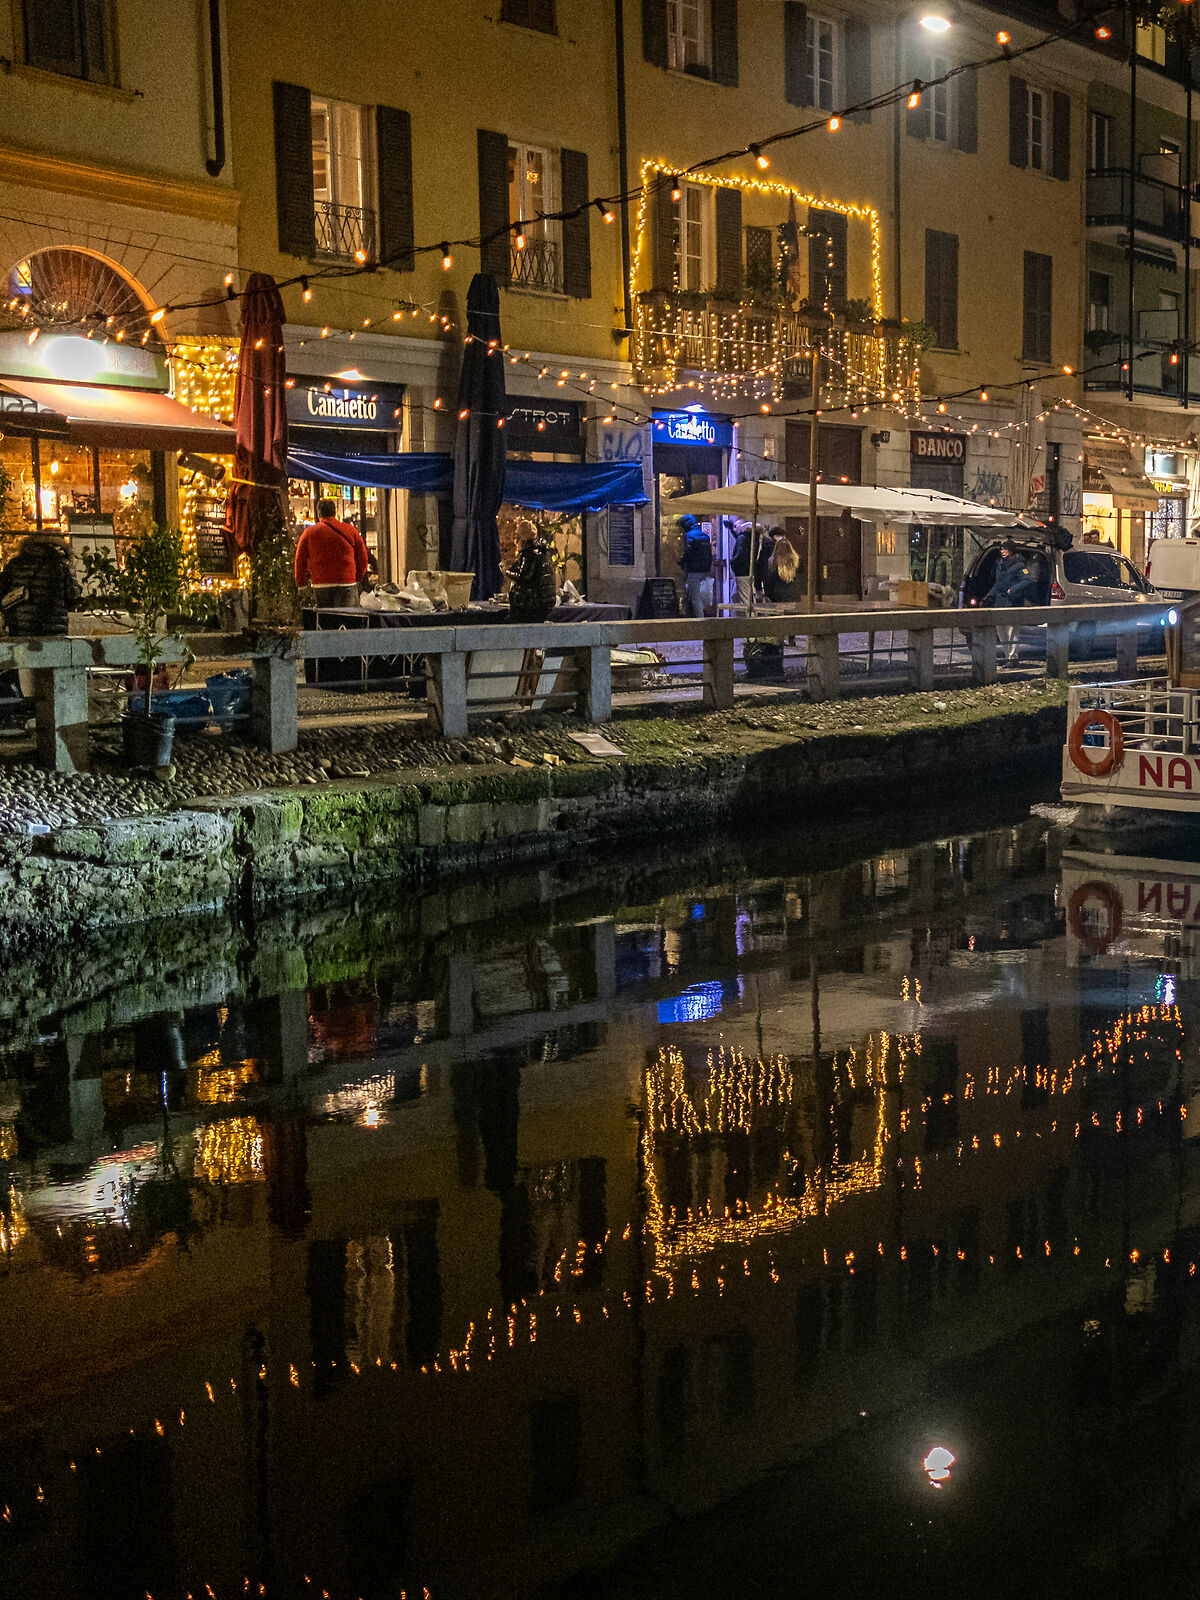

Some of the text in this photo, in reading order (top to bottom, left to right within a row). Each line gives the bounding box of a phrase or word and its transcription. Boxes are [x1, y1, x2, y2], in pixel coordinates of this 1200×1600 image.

[307, 386, 378, 420] Canaletto
[506, 408, 570, 425] STROT
[917, 436, 964, 459] BANCO
